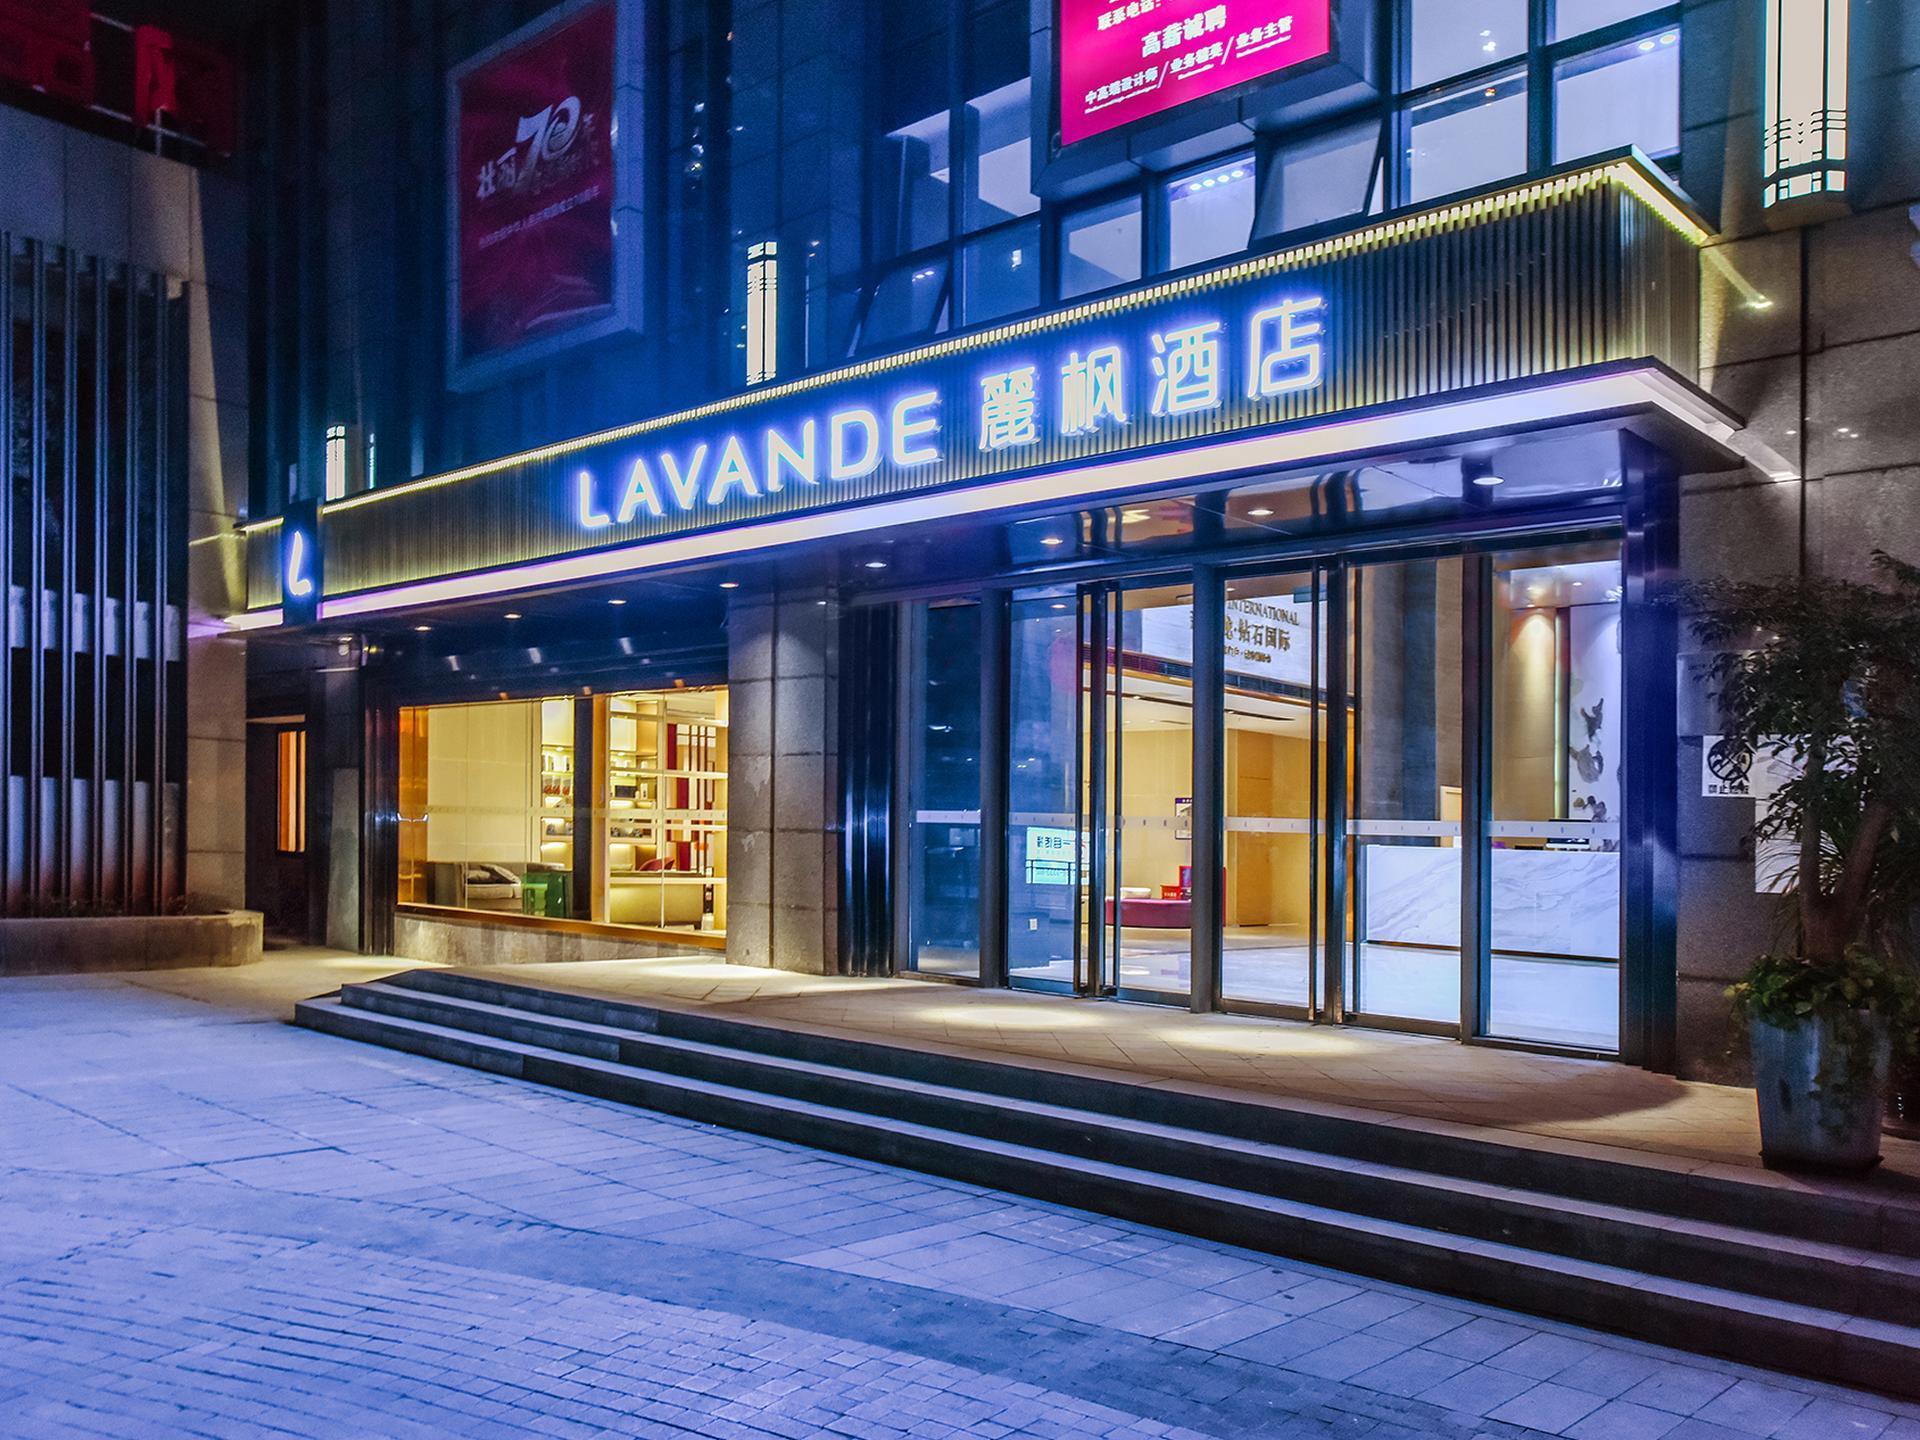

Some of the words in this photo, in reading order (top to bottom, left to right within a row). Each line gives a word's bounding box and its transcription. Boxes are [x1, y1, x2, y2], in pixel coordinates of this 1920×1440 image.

[1141, 4, 1227, 58] 高薪诚聘
[1235, 15, 1293, 49] 业务主管
[578, 391, 939, 528] LAVANDE
[288, 530, 312, 596] L
[1227, 600, 1299, 626] INTERNATIONAL
